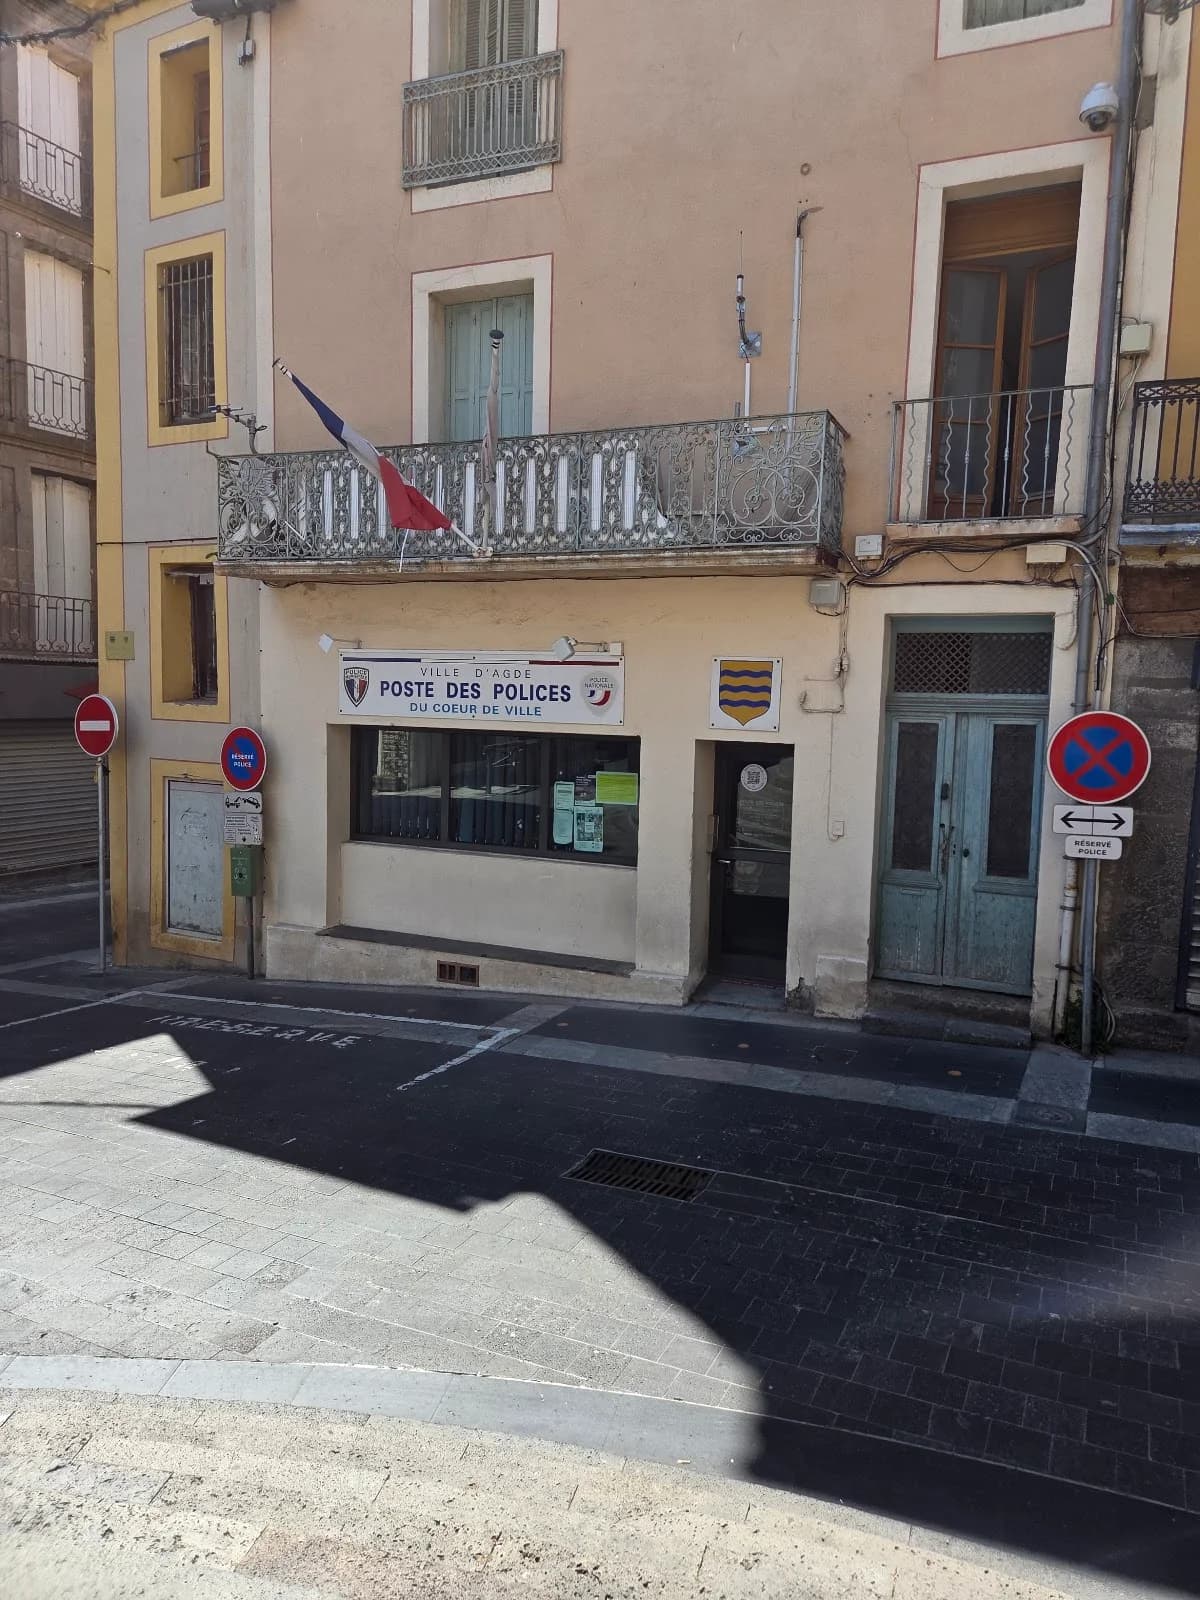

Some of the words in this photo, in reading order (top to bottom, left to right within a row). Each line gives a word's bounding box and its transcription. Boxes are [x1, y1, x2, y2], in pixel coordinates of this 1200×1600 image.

[420, 667, 460, 677] VILLE
[475, 668, 532, 679] D'AGDE
[380, 680, 435, 698] POSTE
[446, 682, 481, 699] DES
[493, 683, 571, 702] POLICES
[410, 702, 428, 712] DU
[432, 703, 477, 714] COEUR
[482, 705, 500, 714] DE
[504, 705, 542, 716] VILLE
[1074, 839, 1112, 848] RÉSERVÉ
[1078, 848, 1108, 856] POLICE
